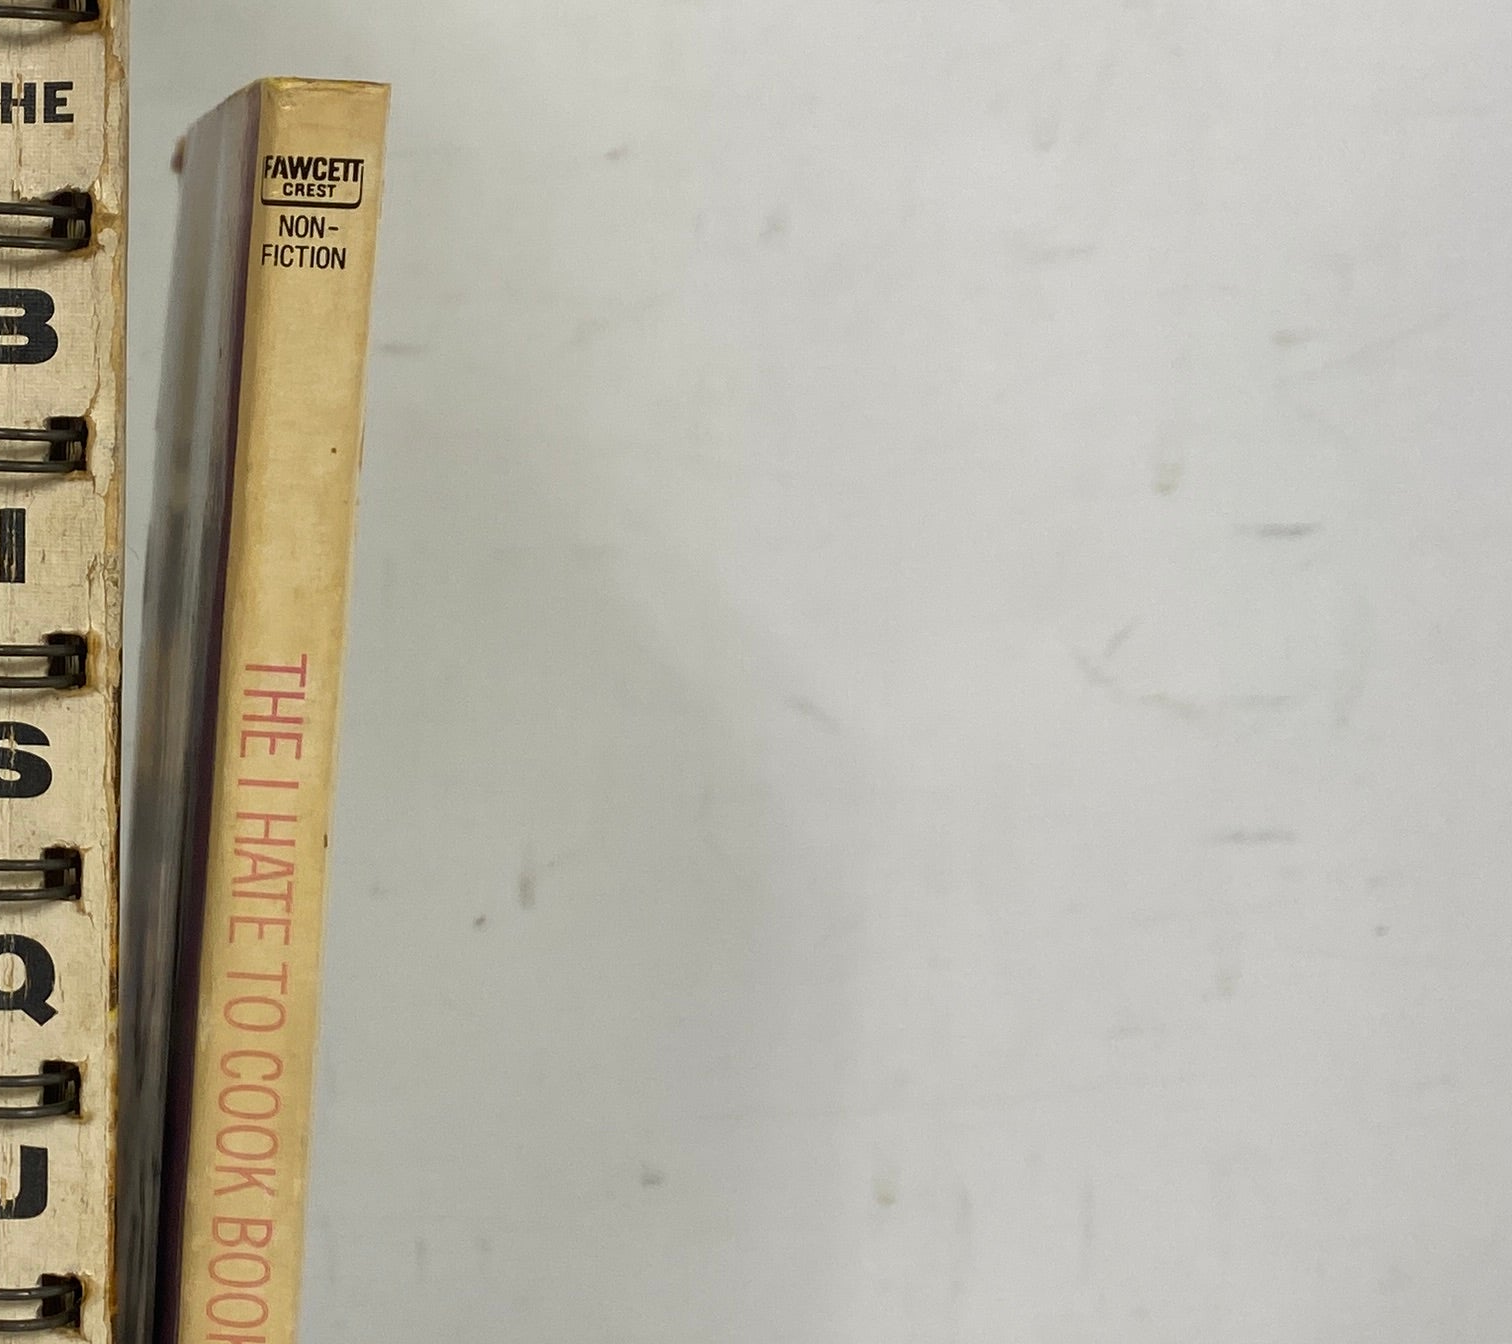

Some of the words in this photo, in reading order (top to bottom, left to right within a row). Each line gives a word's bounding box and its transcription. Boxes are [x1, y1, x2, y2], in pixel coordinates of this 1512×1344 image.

[264, 154, 365, 183] FAWCETT
[282, 182, 337, 198] CREST
[278, 214, 339, 239] NON-
[261, 243, 346, 270] FICTION
[241, 653, 308, 759] THE
[237, 778, 299, 790] I
[229, 811, 297, 944] HATE
[223, 964, 288, 1034] TO
[215, 1050, 283, 1195] COOK
